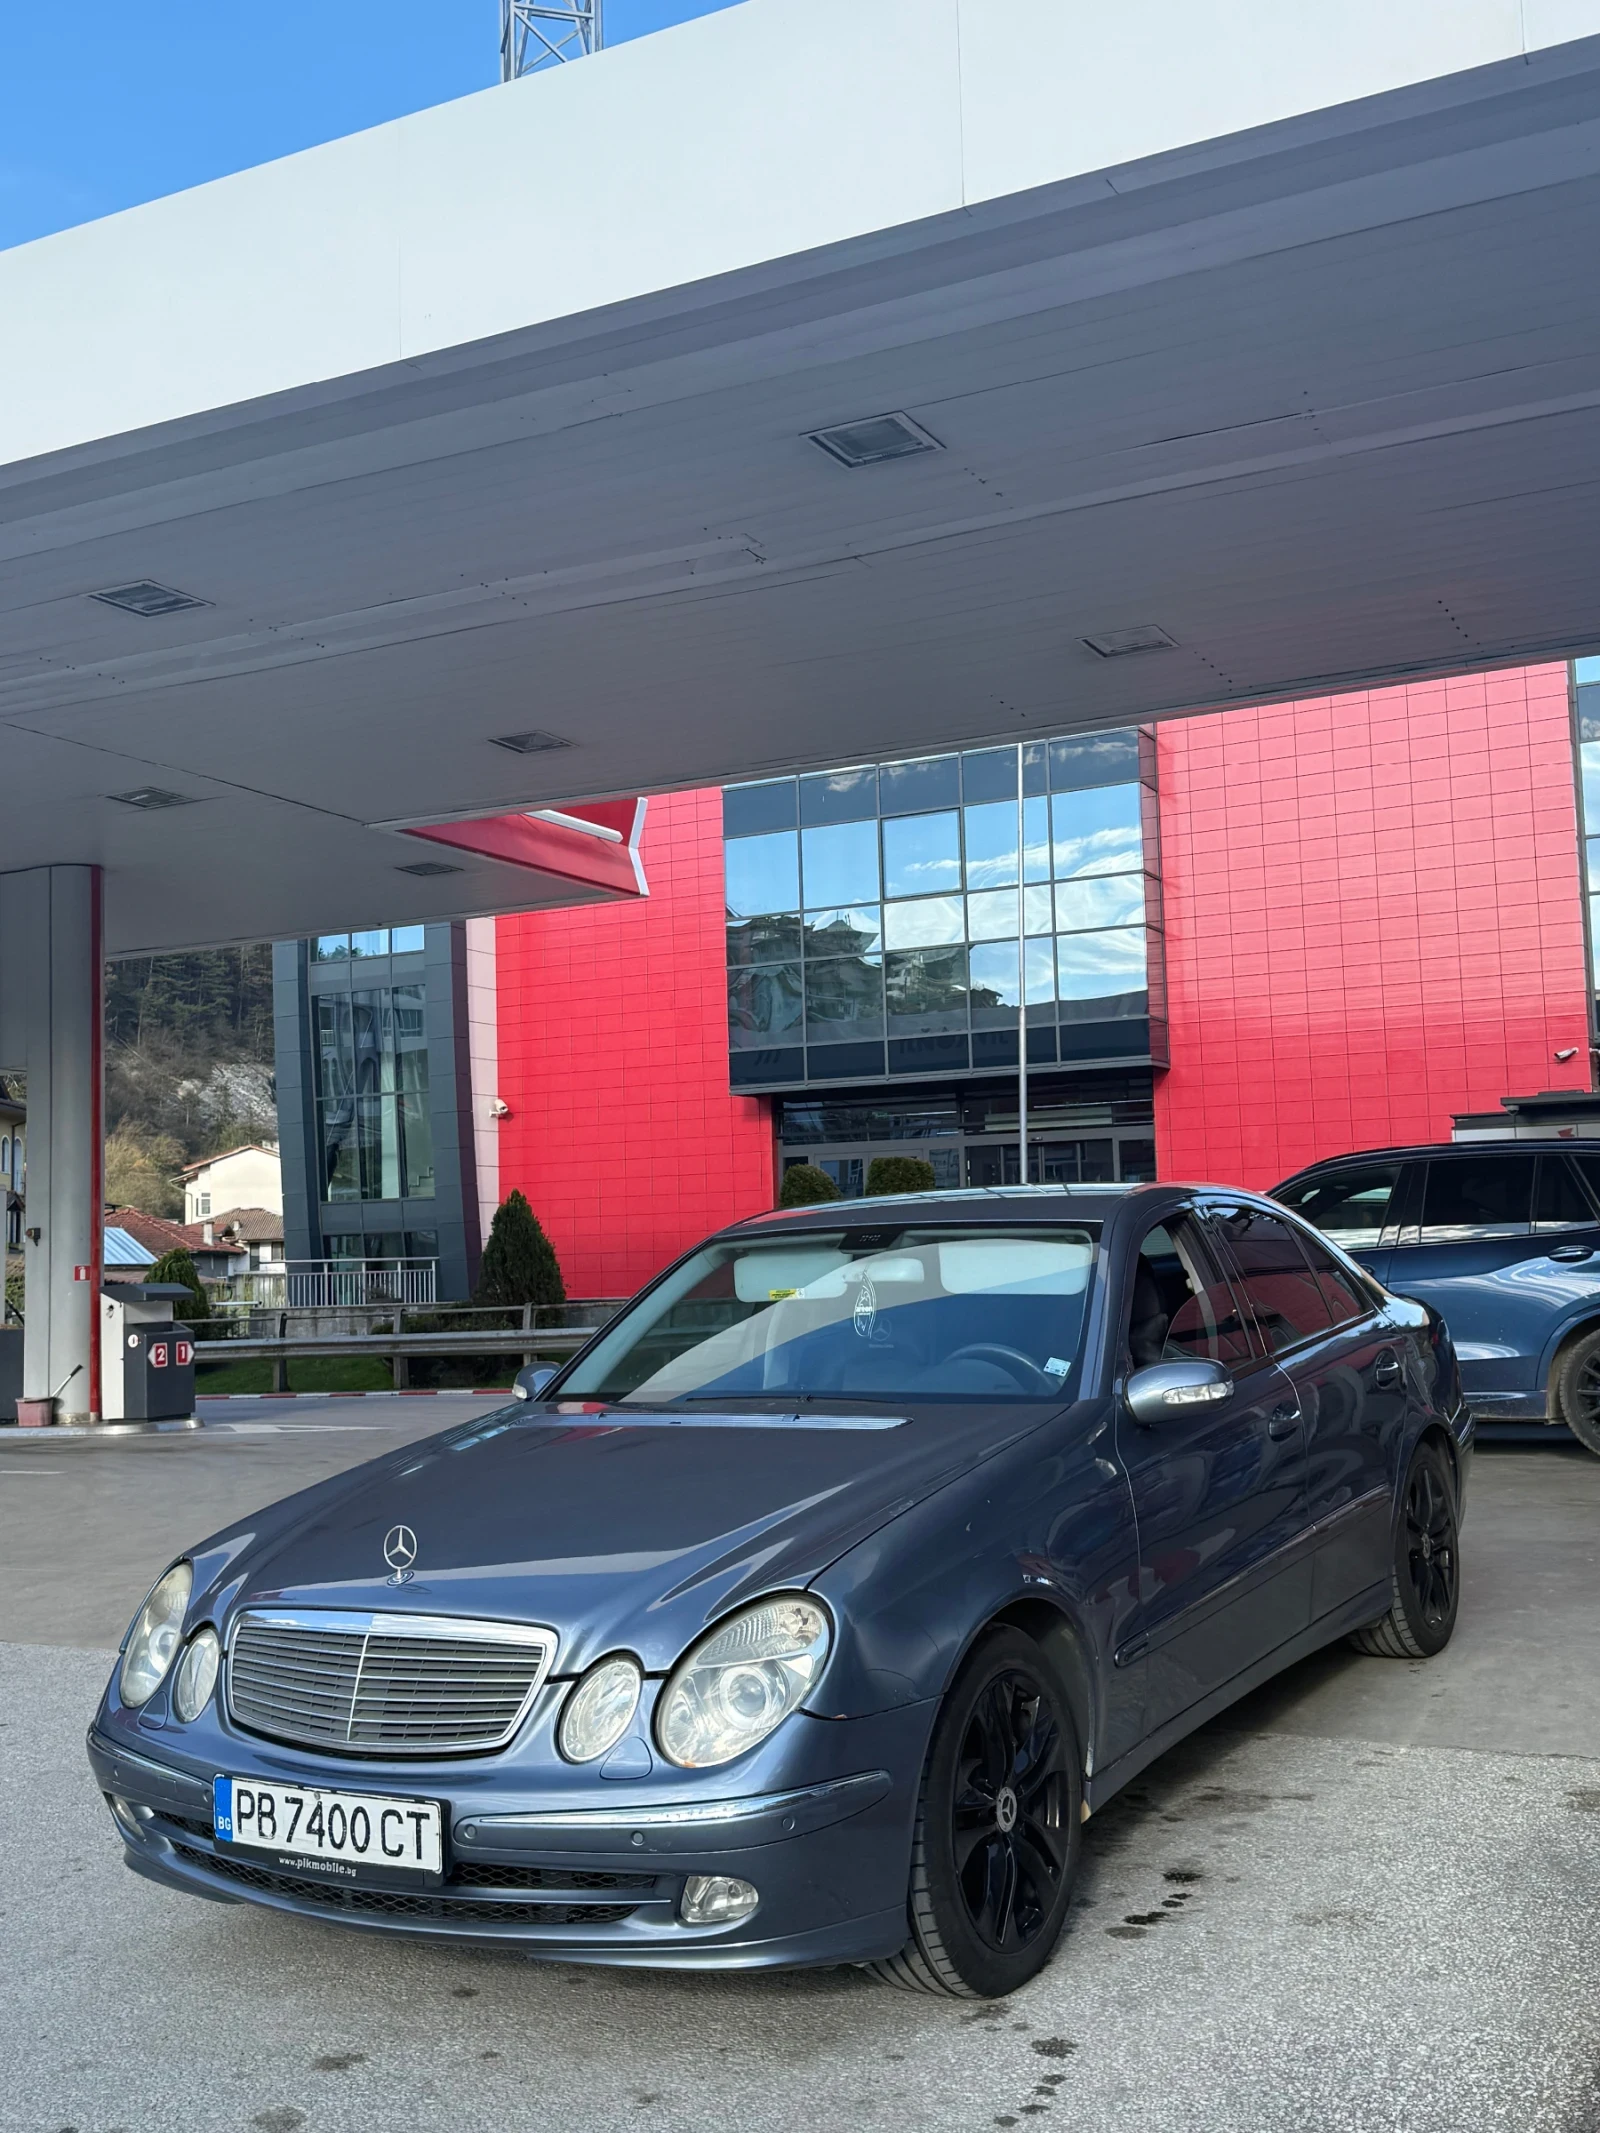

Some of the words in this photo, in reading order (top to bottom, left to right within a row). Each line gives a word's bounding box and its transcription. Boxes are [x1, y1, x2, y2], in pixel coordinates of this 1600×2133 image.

[157, 1347, 165, 1361] 2
[218, 1816, 232, 1831] BG
[236, 1788, 277, 1840] PB
[285, 1796, 371, 1853] 7400
[381, 1808, 430, 1860] CT
